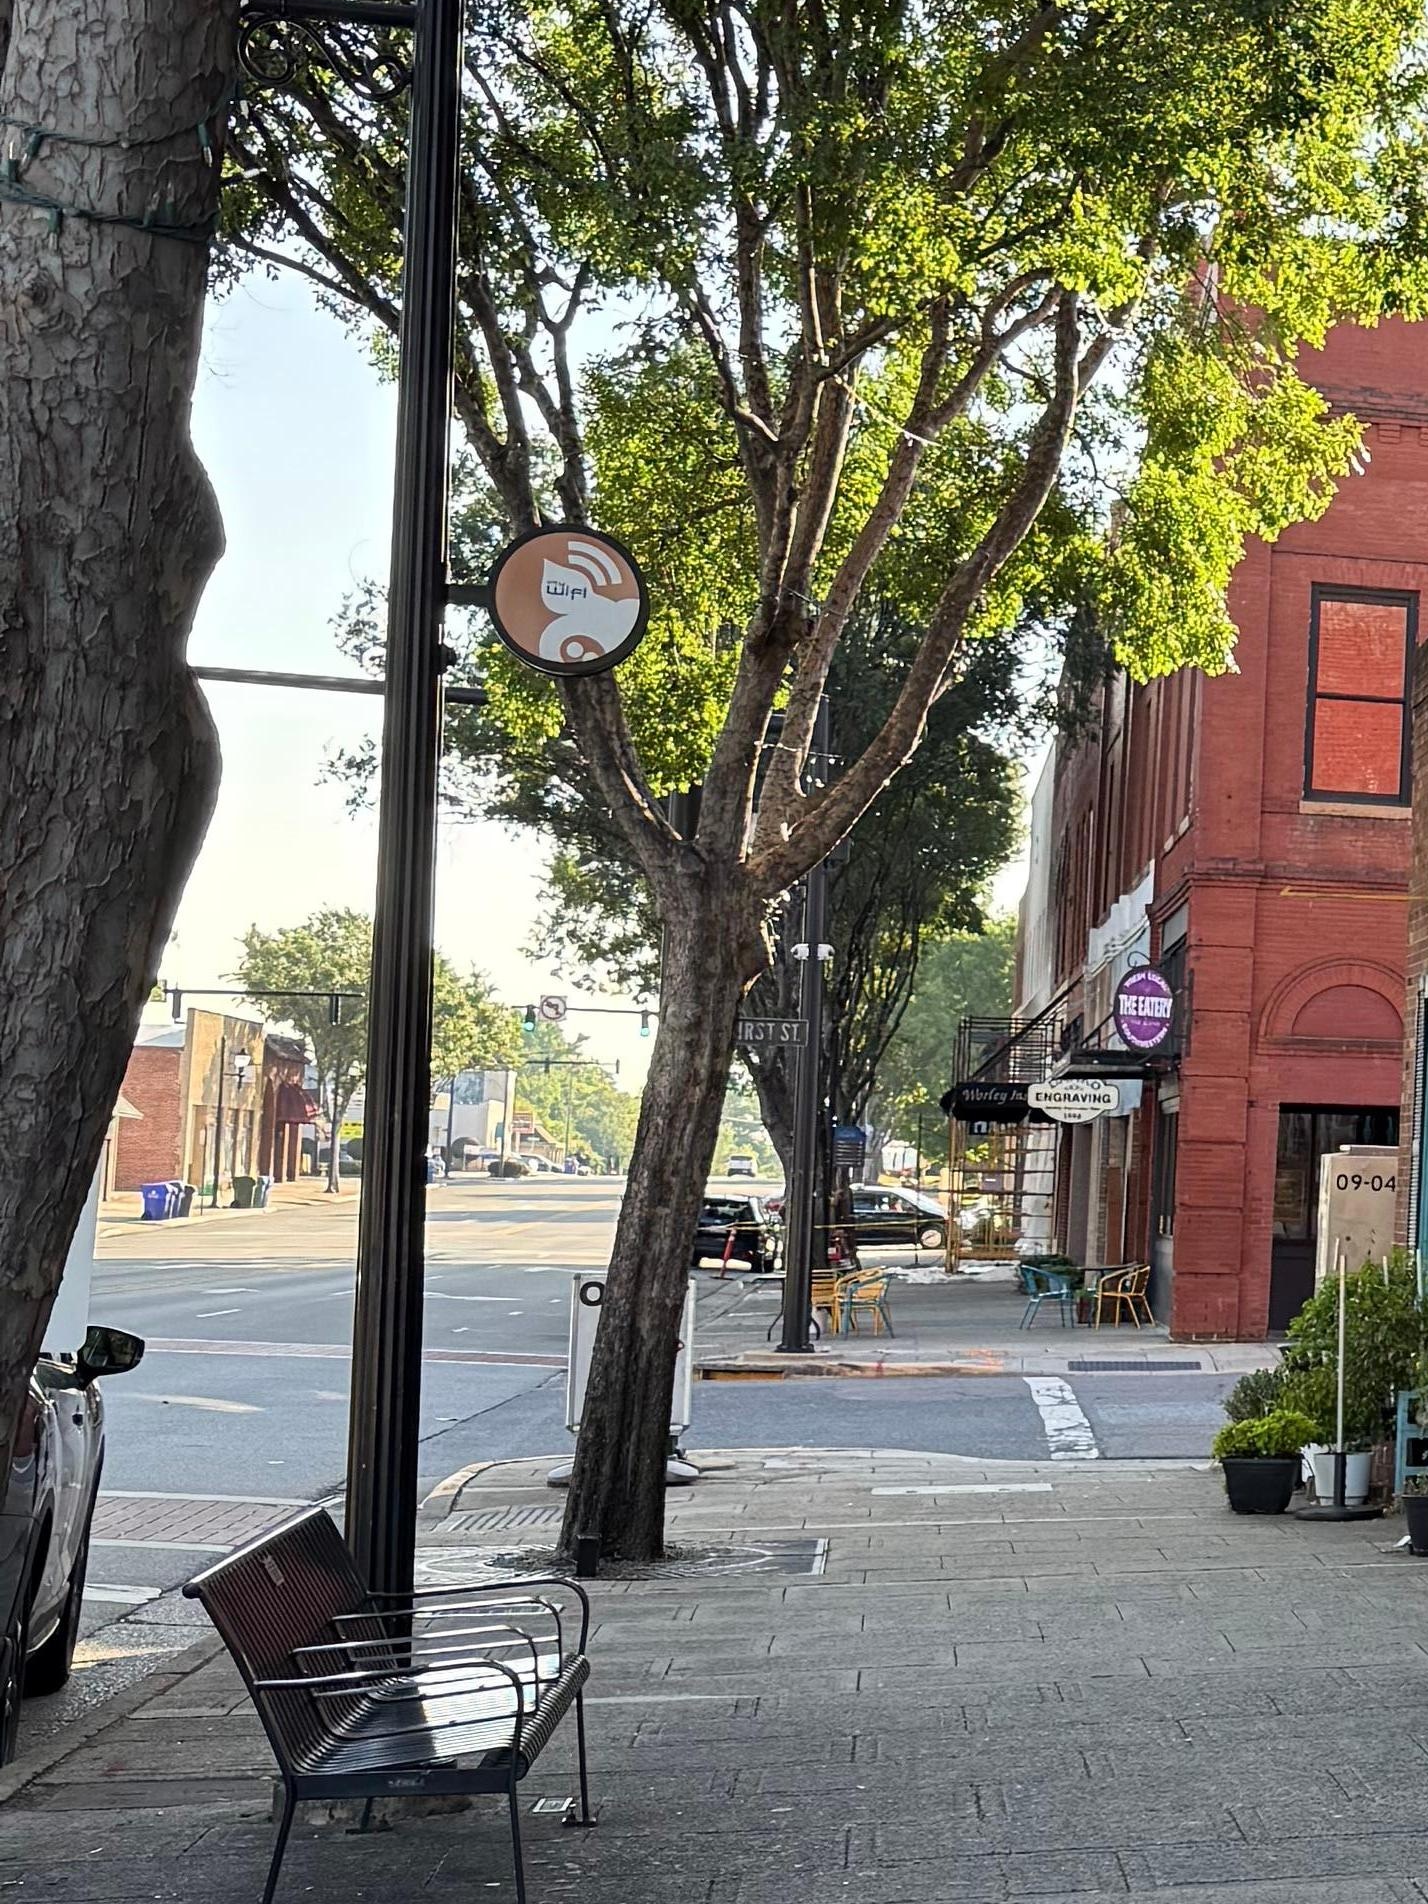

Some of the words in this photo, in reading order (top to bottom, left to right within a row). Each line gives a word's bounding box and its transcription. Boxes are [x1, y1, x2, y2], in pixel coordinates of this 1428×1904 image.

[1119, 994, 1138, 1016] THE
[1138, 995, 1174, 1018] EATERY
[737, 1022, 773, 1041] IRST
[1035, 1092, 1112, 1104] ENGRAVING
[1336, 1174, 1396, 1193] 09-04
